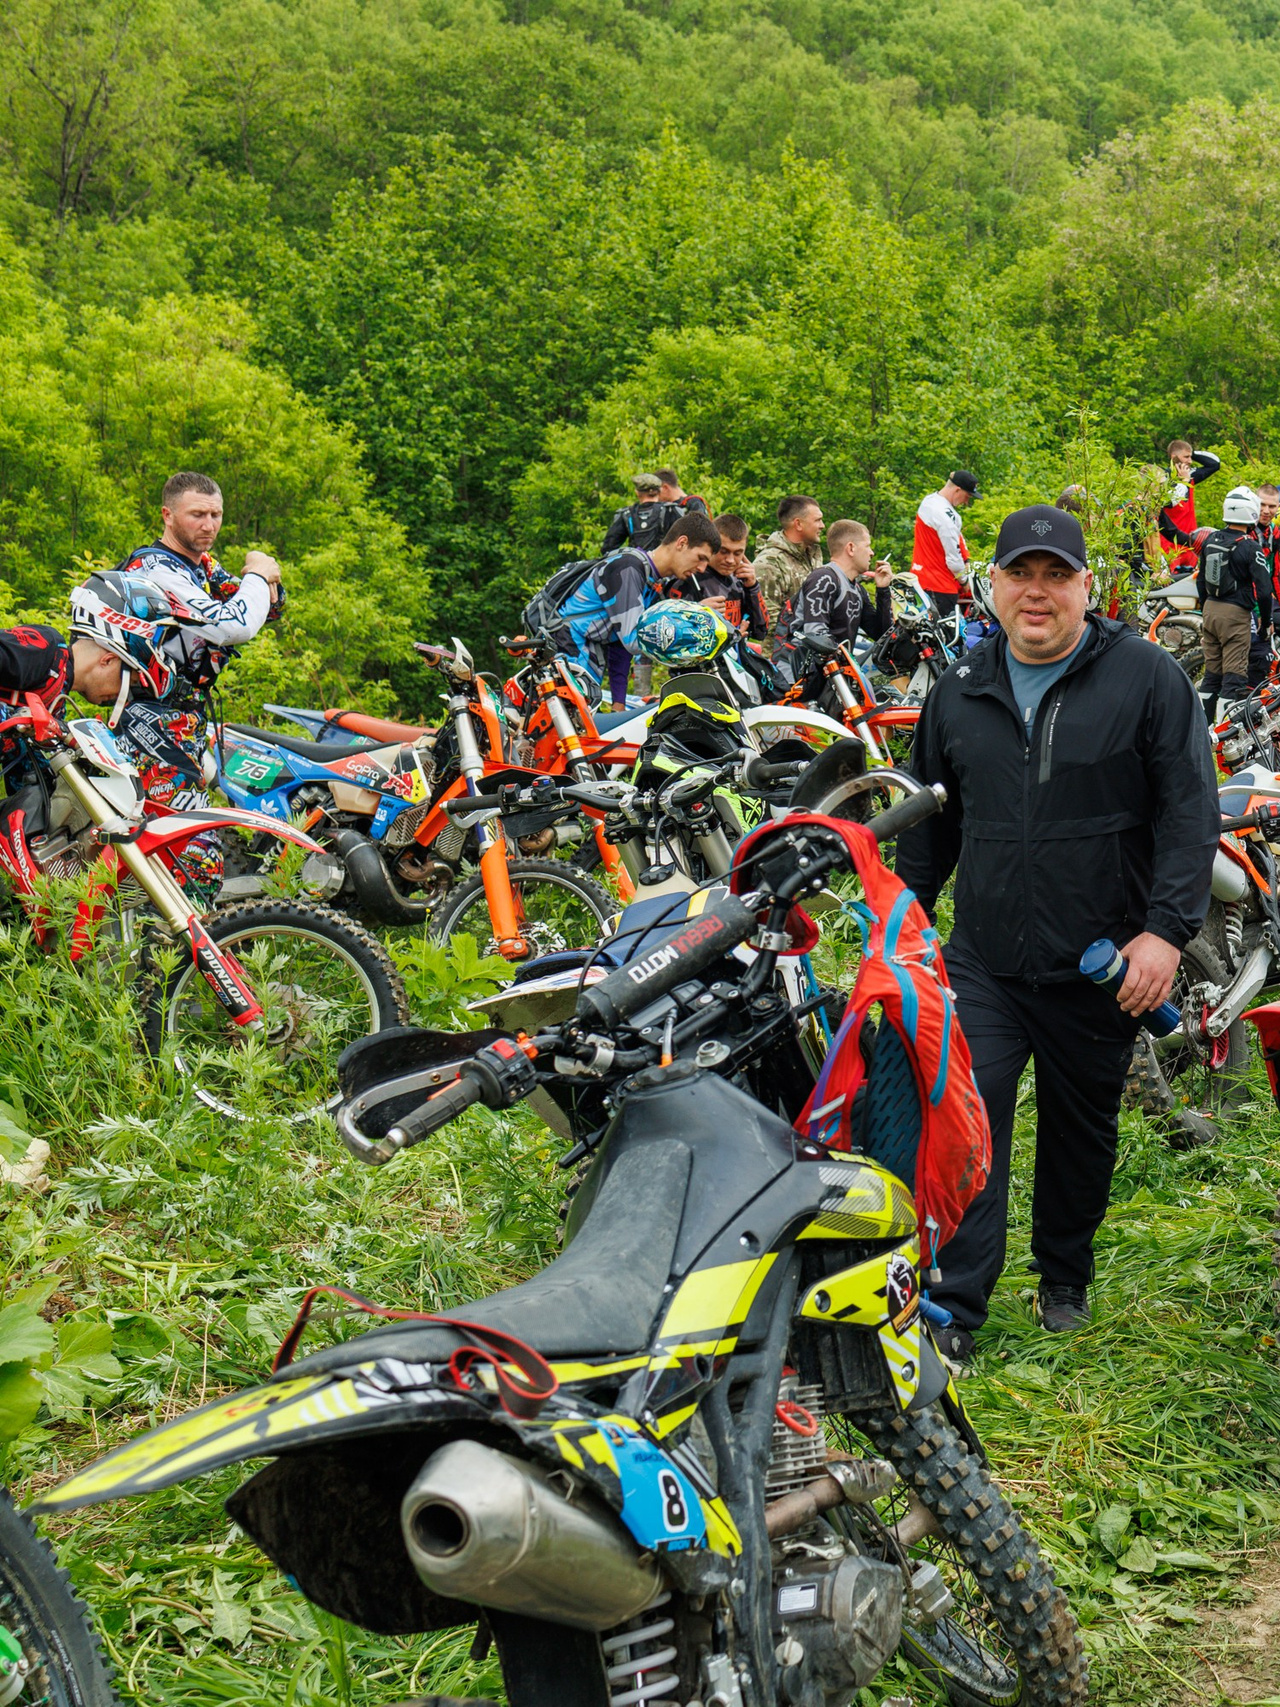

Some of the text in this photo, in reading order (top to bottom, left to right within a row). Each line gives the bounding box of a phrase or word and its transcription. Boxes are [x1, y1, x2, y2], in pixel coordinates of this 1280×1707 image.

[98, 606, 154, 639] 100%
[130, 705, 156, 723] ONEAL
[134, 721, 158, 745] RIDERS
[234, 759, 271, 781] 76
[13, 829, 31, 878] HONDA
[627, 914, 724, 985] REGULMOTO
[200, 947, 249, 1008] DUNLOP
[659, 1471, 687, 1531] 8
